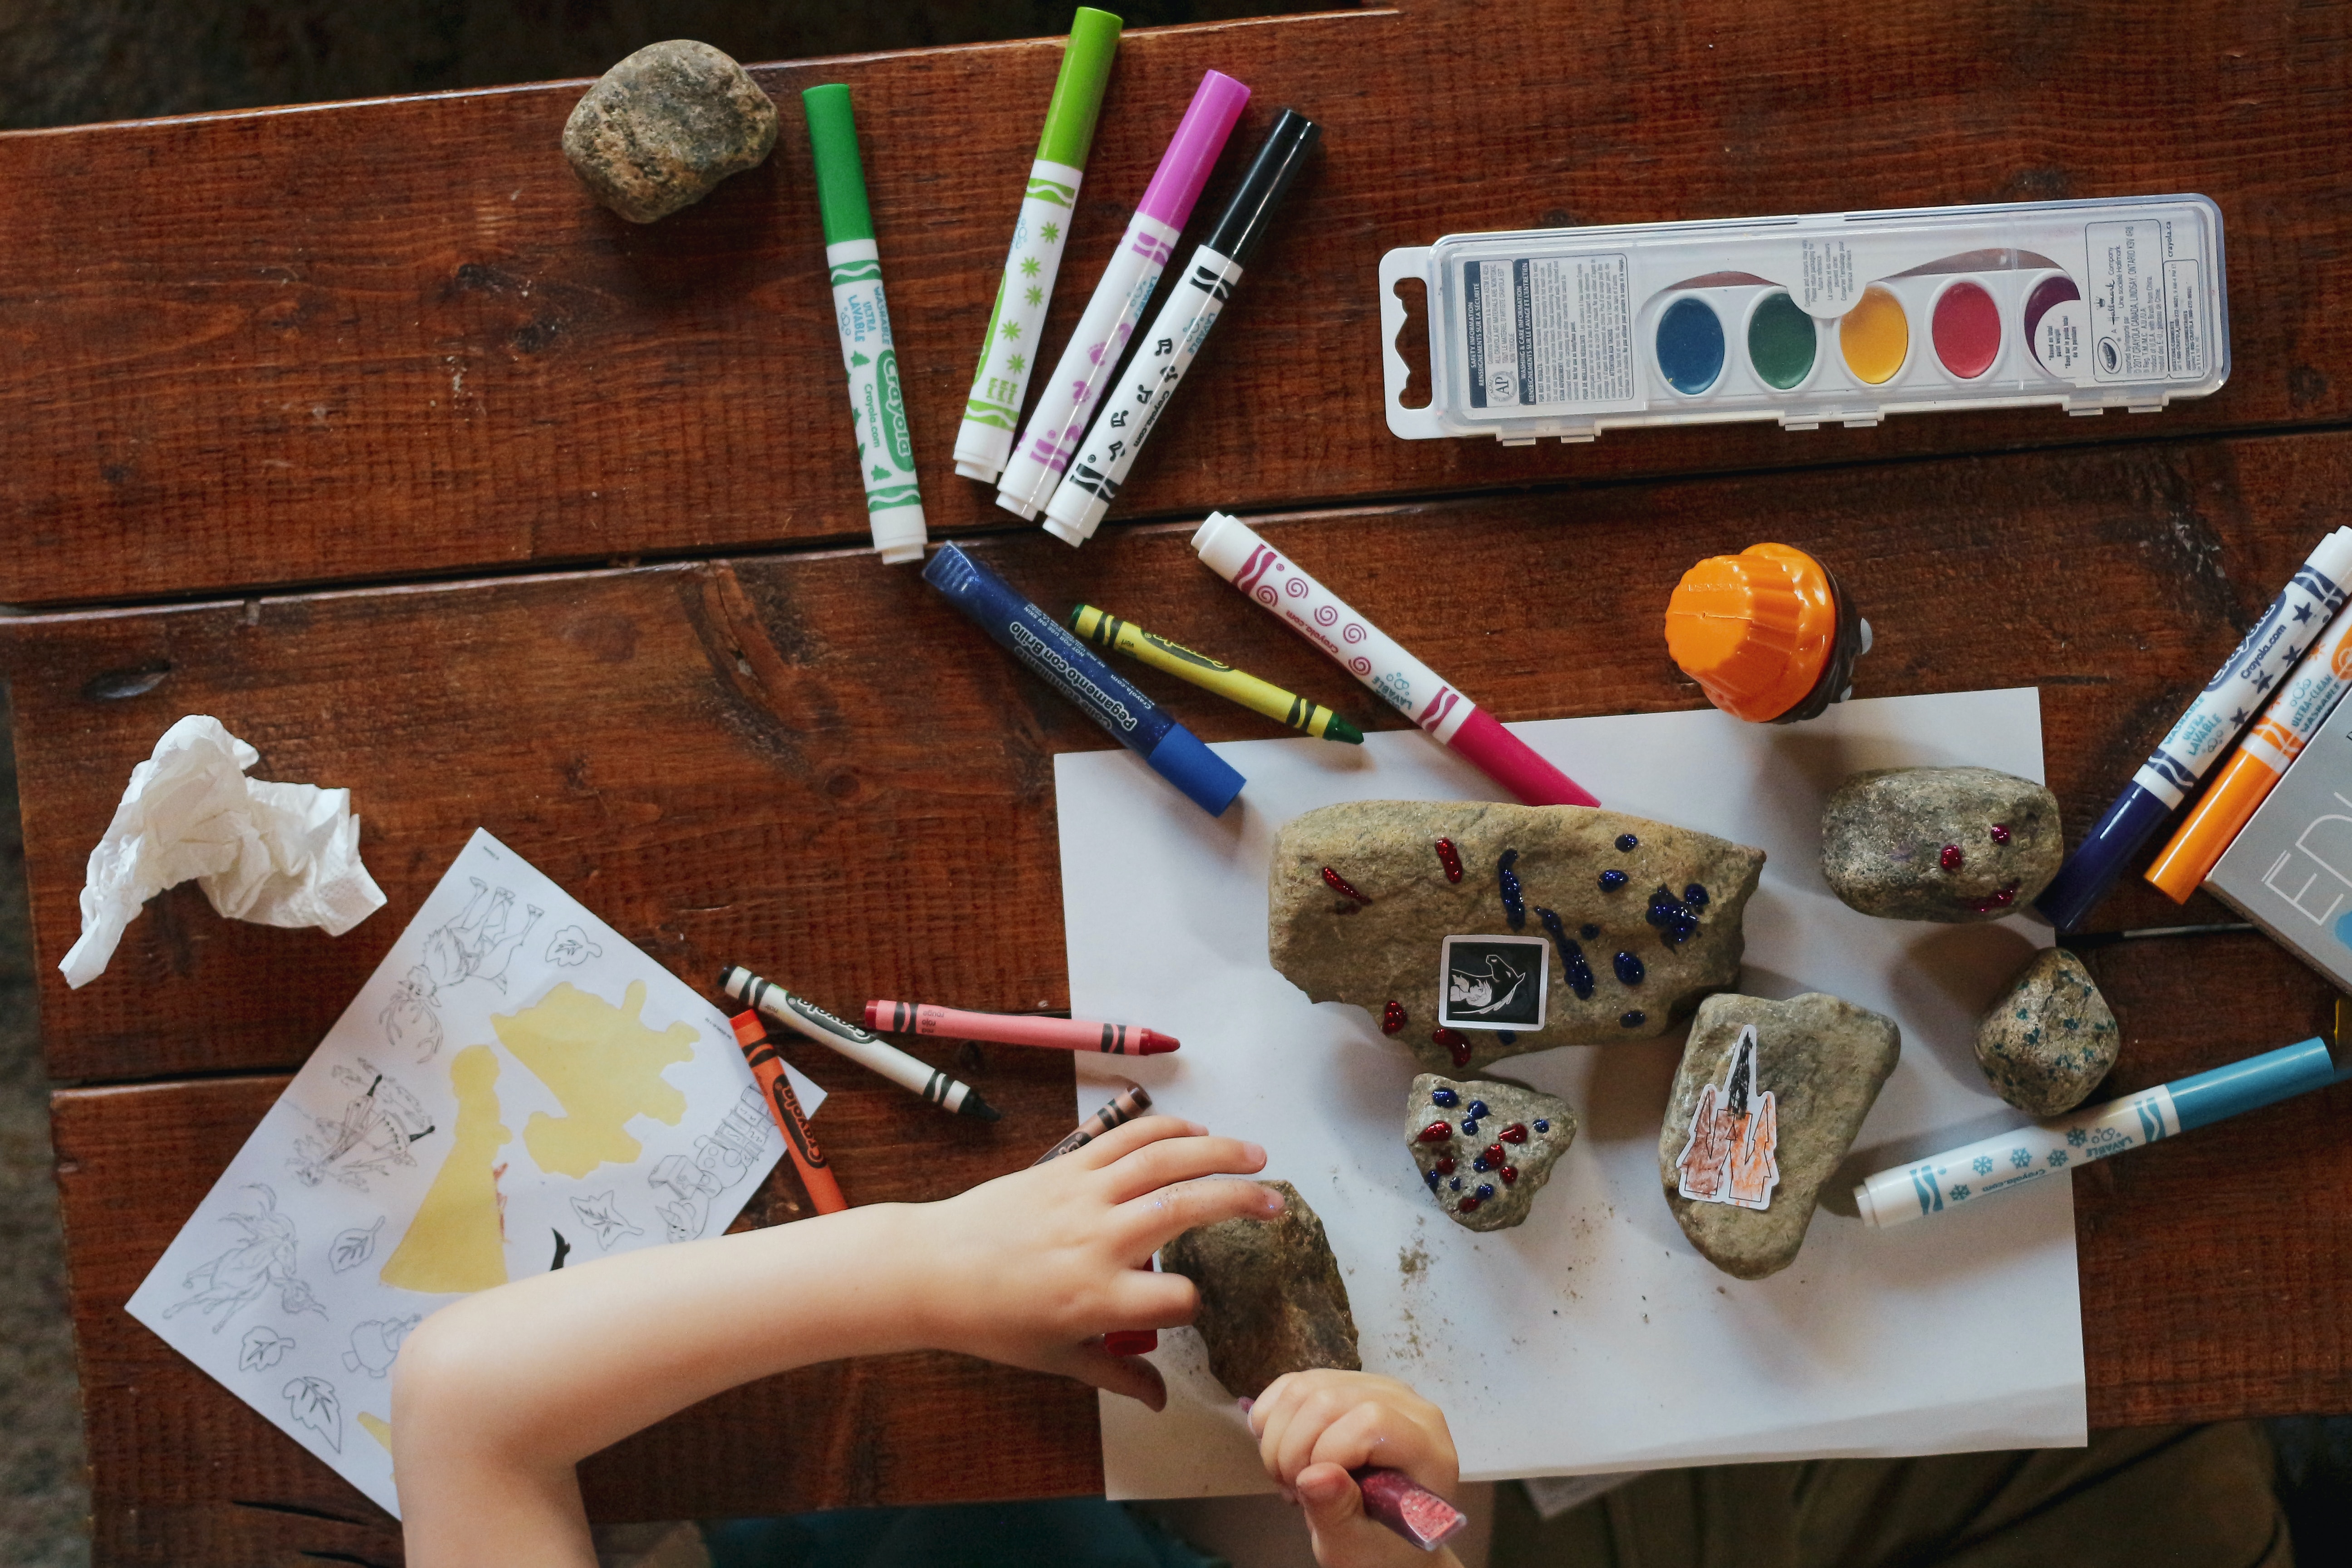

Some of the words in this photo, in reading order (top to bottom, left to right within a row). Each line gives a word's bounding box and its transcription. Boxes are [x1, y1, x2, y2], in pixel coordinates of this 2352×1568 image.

[2165, 221, 2174, 257] crayola.ca
[2107, 246, 2116, 274] Company
[2127, 250, 2137, 274] ONTARIO
[1521, 262, 1529, 298] L'ENTRETIEN
[848, 294, 865, 342] LAVABLE
[863, 301, 876, 332] ULTRA
[874, 286, 893, 344] WASHABLE
[1516, 285, 1524, 328] INFORMATION
[2105, 279, 2120, 325] Hallmark
[1467, 301, 1475, 345] INFORMATION
[2131, 327, 2141, 353] CRAYOLA
[1475, 333, 1485, 386] RENSEIGNEMENTS
[1526, 350, 1535, 402] RENSEIGNEMENTS
[2132, 354, 2142, 368] 2017
[1494, 376, 1509, 395] AP
[864, 383, 880, 447] Crayola.com
[883, 356, 911, 457] Crayola
[1133, 390, 1170, 447] Crayola.com
[1024, 606, 1038, 619] SKIN
[1027, 604, 1041, 616] PEAU
[1038, 618, 1047, 626] ON
[1050, 622, 1061, 632] SUR
[1009, 621, 1047, 656] Brillo
[1047, 625, 1059, 637] USE
[1059, 636, 1072, 646] FOR
[1063, 631, 1086, 652] UTILISER
[1286, 611, 1338, 653] Crayola.com
[1041, 647, 1069, 672] con
[1072, 647, 1085, 657] NOT
[1087, 652, 1097, 662] PAS
[2240, 625, 2286, 679] Crayola.com
[1065, 667, 1137, 730] Pegamento
[1111, 674, 1154, 709] Crayola.com
[1372, 676, 1411, 709] LAVABLE
[2292, 675, 2332, 727] ULTRA-CLEAN
[2300, 682, 2339, 732] WASHABLE
[2180, 715, 2205, 740] ULTRA
[2183, 711, 2221, 756] LAVABLE
[921, 1009, 944, 1018] rouge
[921, 1018, 936, 1026] rojo
[782, 1084, 823, 1162] Crayola
[1982, 1169, 2045, 1191] Crayola.com
